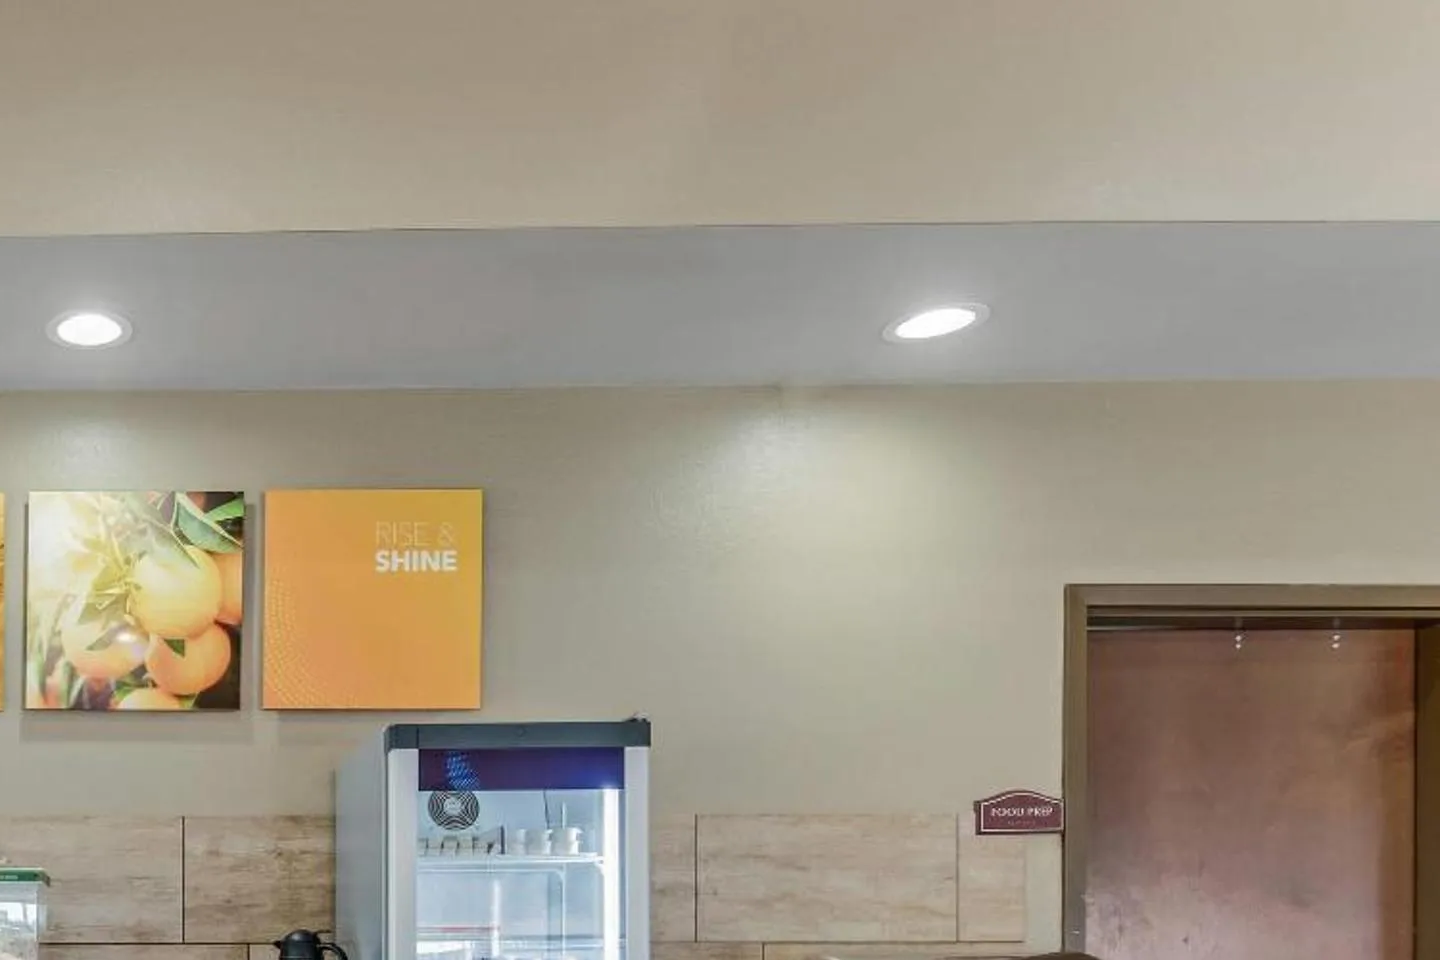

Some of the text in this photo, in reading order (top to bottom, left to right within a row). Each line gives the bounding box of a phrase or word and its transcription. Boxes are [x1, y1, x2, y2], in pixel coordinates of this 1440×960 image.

[376, 521, 455, 547] RISE &
[375, 550, 458, 572] SHINE
